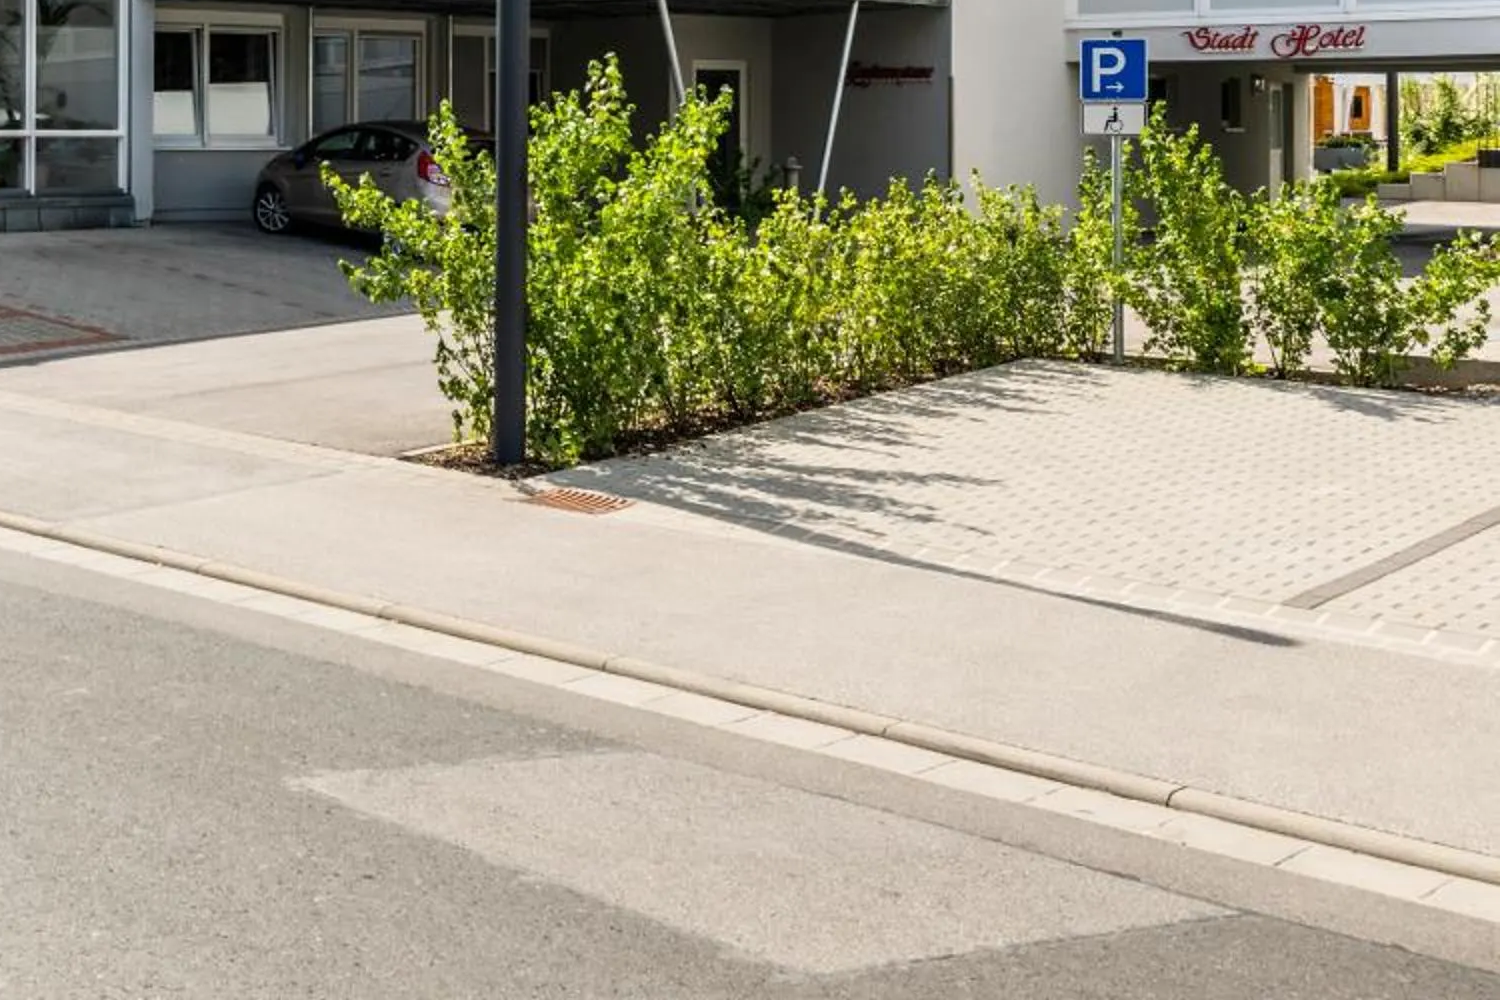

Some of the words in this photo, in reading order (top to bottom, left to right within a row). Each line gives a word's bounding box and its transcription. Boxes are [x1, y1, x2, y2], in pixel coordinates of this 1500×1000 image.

[1182, 24, 1259, 51] Stadt
[1271, 24, 1366, 58] Hotel
[1091, 47, 1126, 93] P
